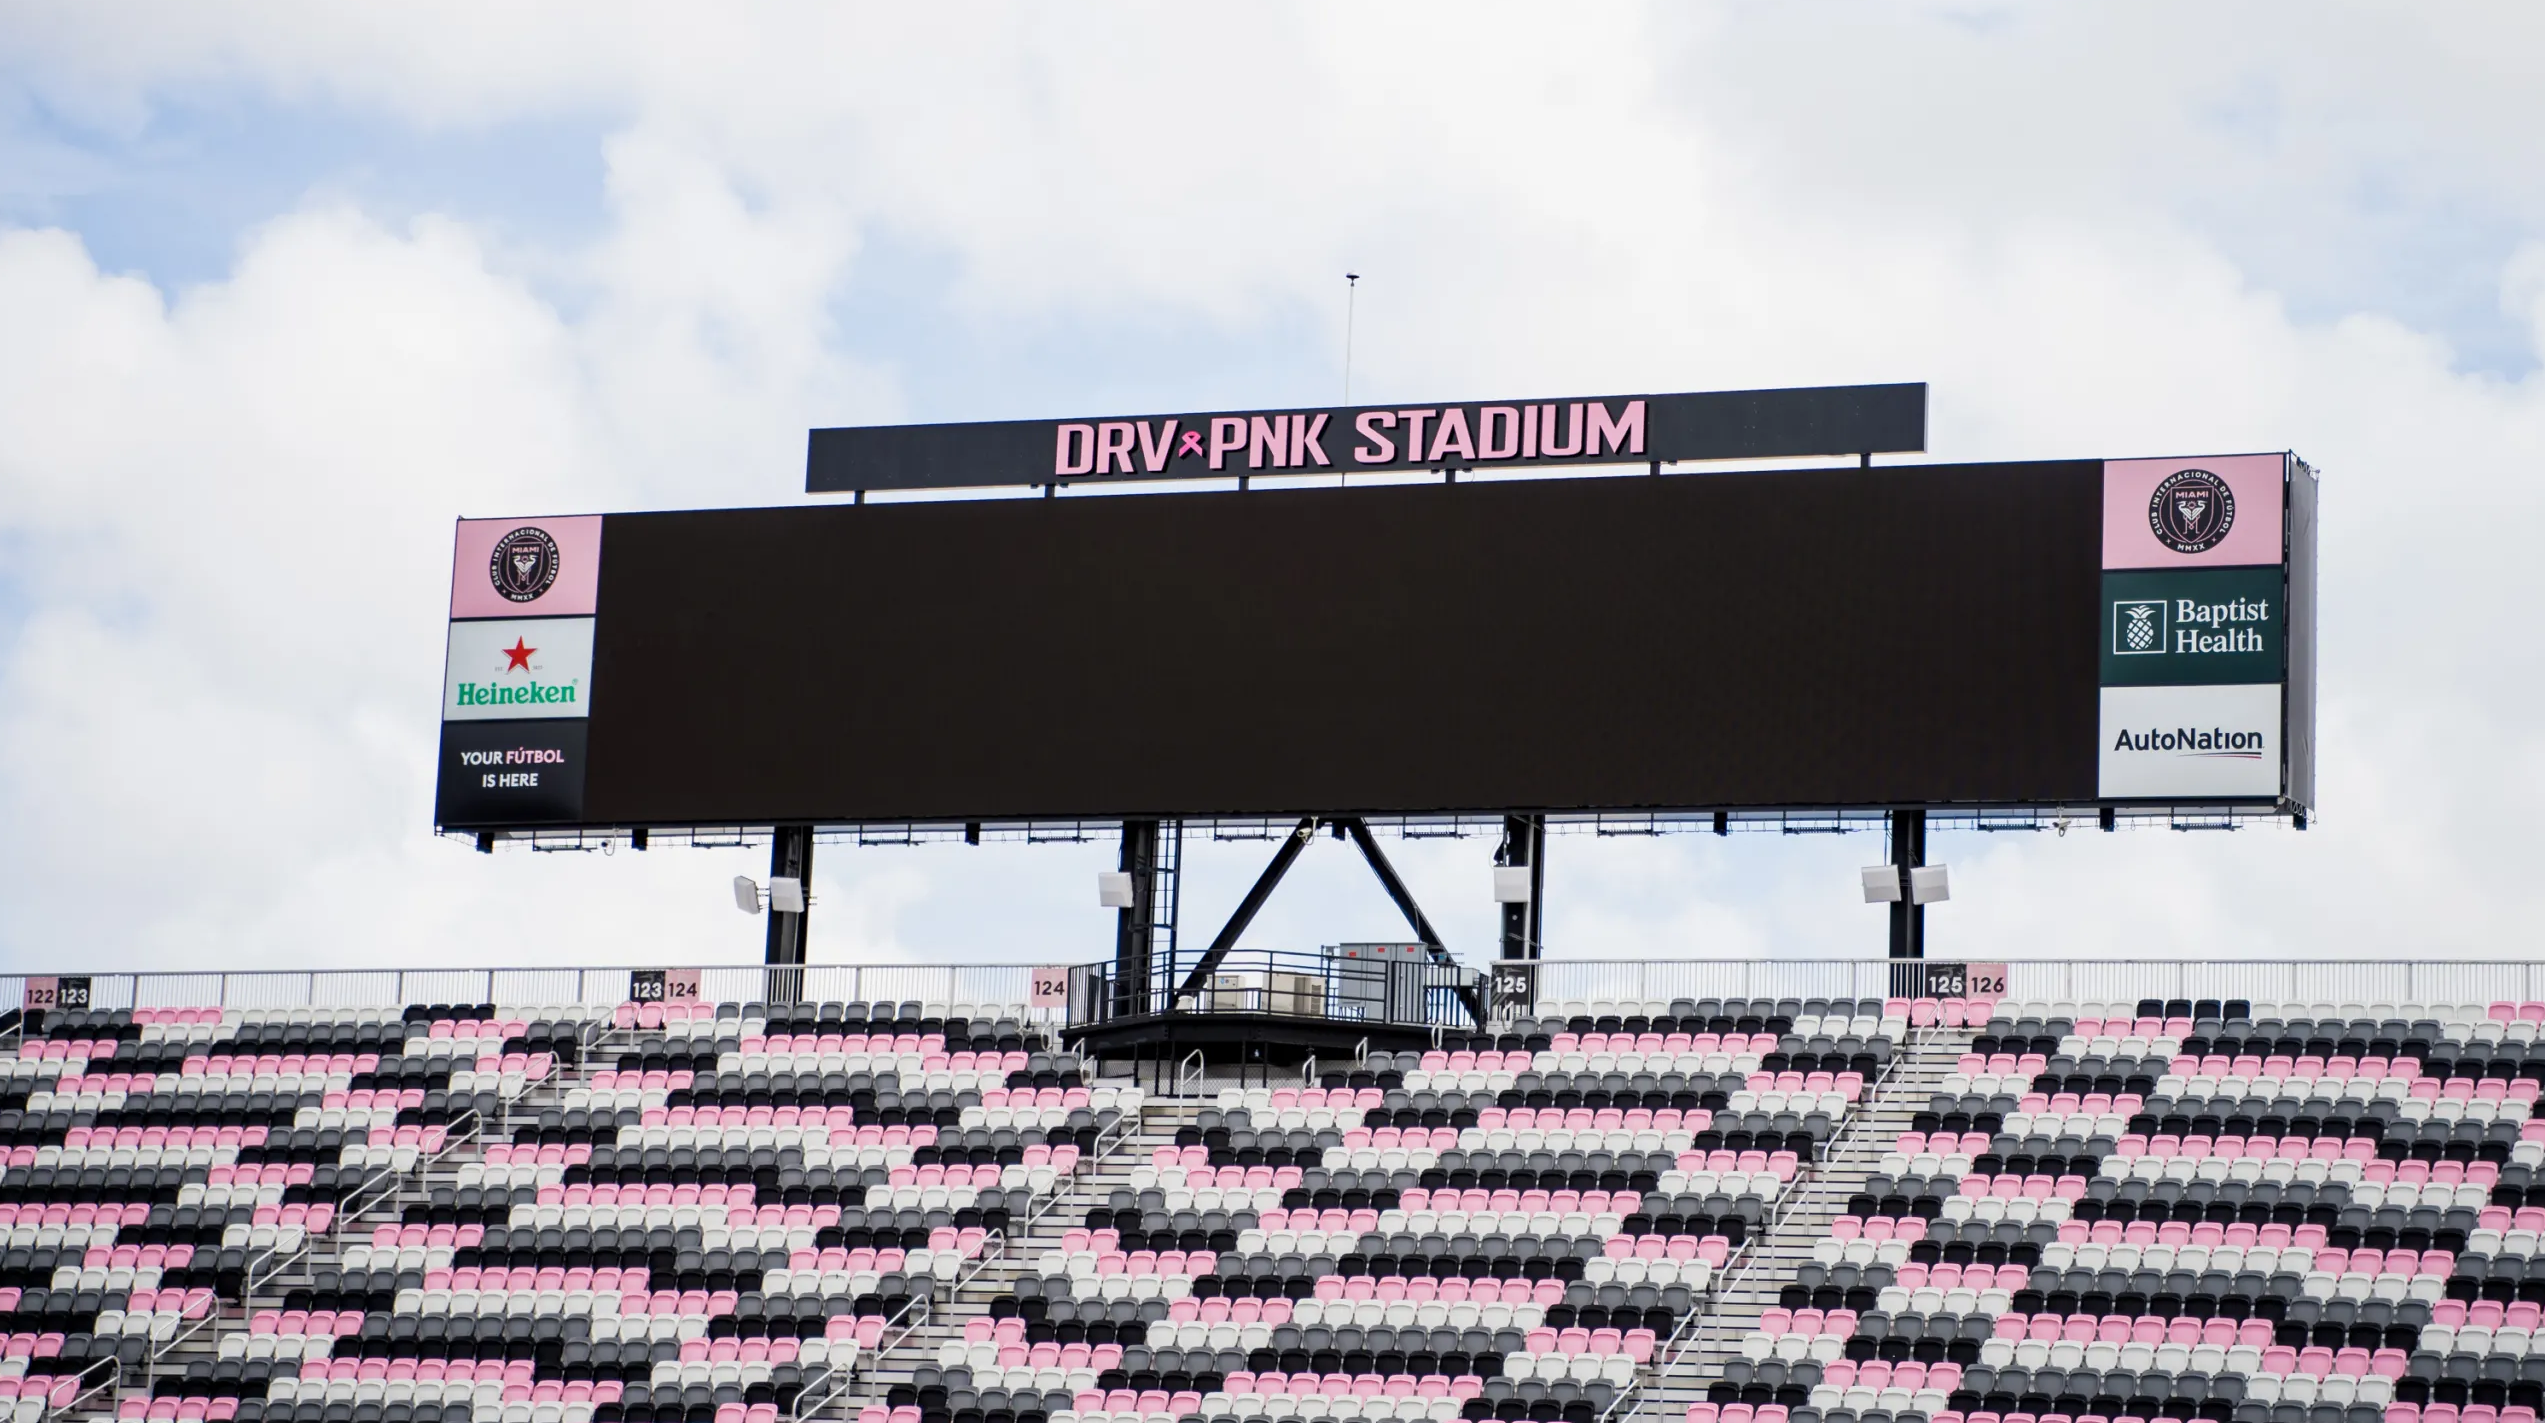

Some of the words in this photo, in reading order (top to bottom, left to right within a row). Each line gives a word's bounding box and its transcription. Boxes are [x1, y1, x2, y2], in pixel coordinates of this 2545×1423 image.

[1055, 419, 1179, 476] DRV
[1209, 413, 1332, 470] PNK
[1354, 400, 1646, 464] STADIUM
[2152, 472, 2219, 508] INTERNACIONAL
[2175, 491, 2209, 499] MIAMI
[2219, 486, 2230, 497] DE
[2151, 512, 2163, 535] CLUB
[492, 529, 548, 562] INTERNACIONAL
[2177, 543, 2205, 551] MMXX
[491, 565, 501, 586] CLUB
[2175, 597, 2269, 628] Baptist
[2175, 627, 2264, 654] Health
[2114, 727, 2263, 751] AutoNation
[461, 751, 503, 765] YOUR
[506, 747, 564, 764] FÚTBOL
[482, 774, 496, 788] IS
[499, 773, 538, 787] HERE
[633, 982, 662, 998] 123
[668, 982, 697, 997] 124
[1034, 981, 1065, 996] 124
[1495, 977, 1527, 993] 125
[1929, 976, 1963, 993] 125
[1971, 977, 2004, 993] 126
[27, 989, 54, 1004] 122
[60, 988, 88, 1004] 123
